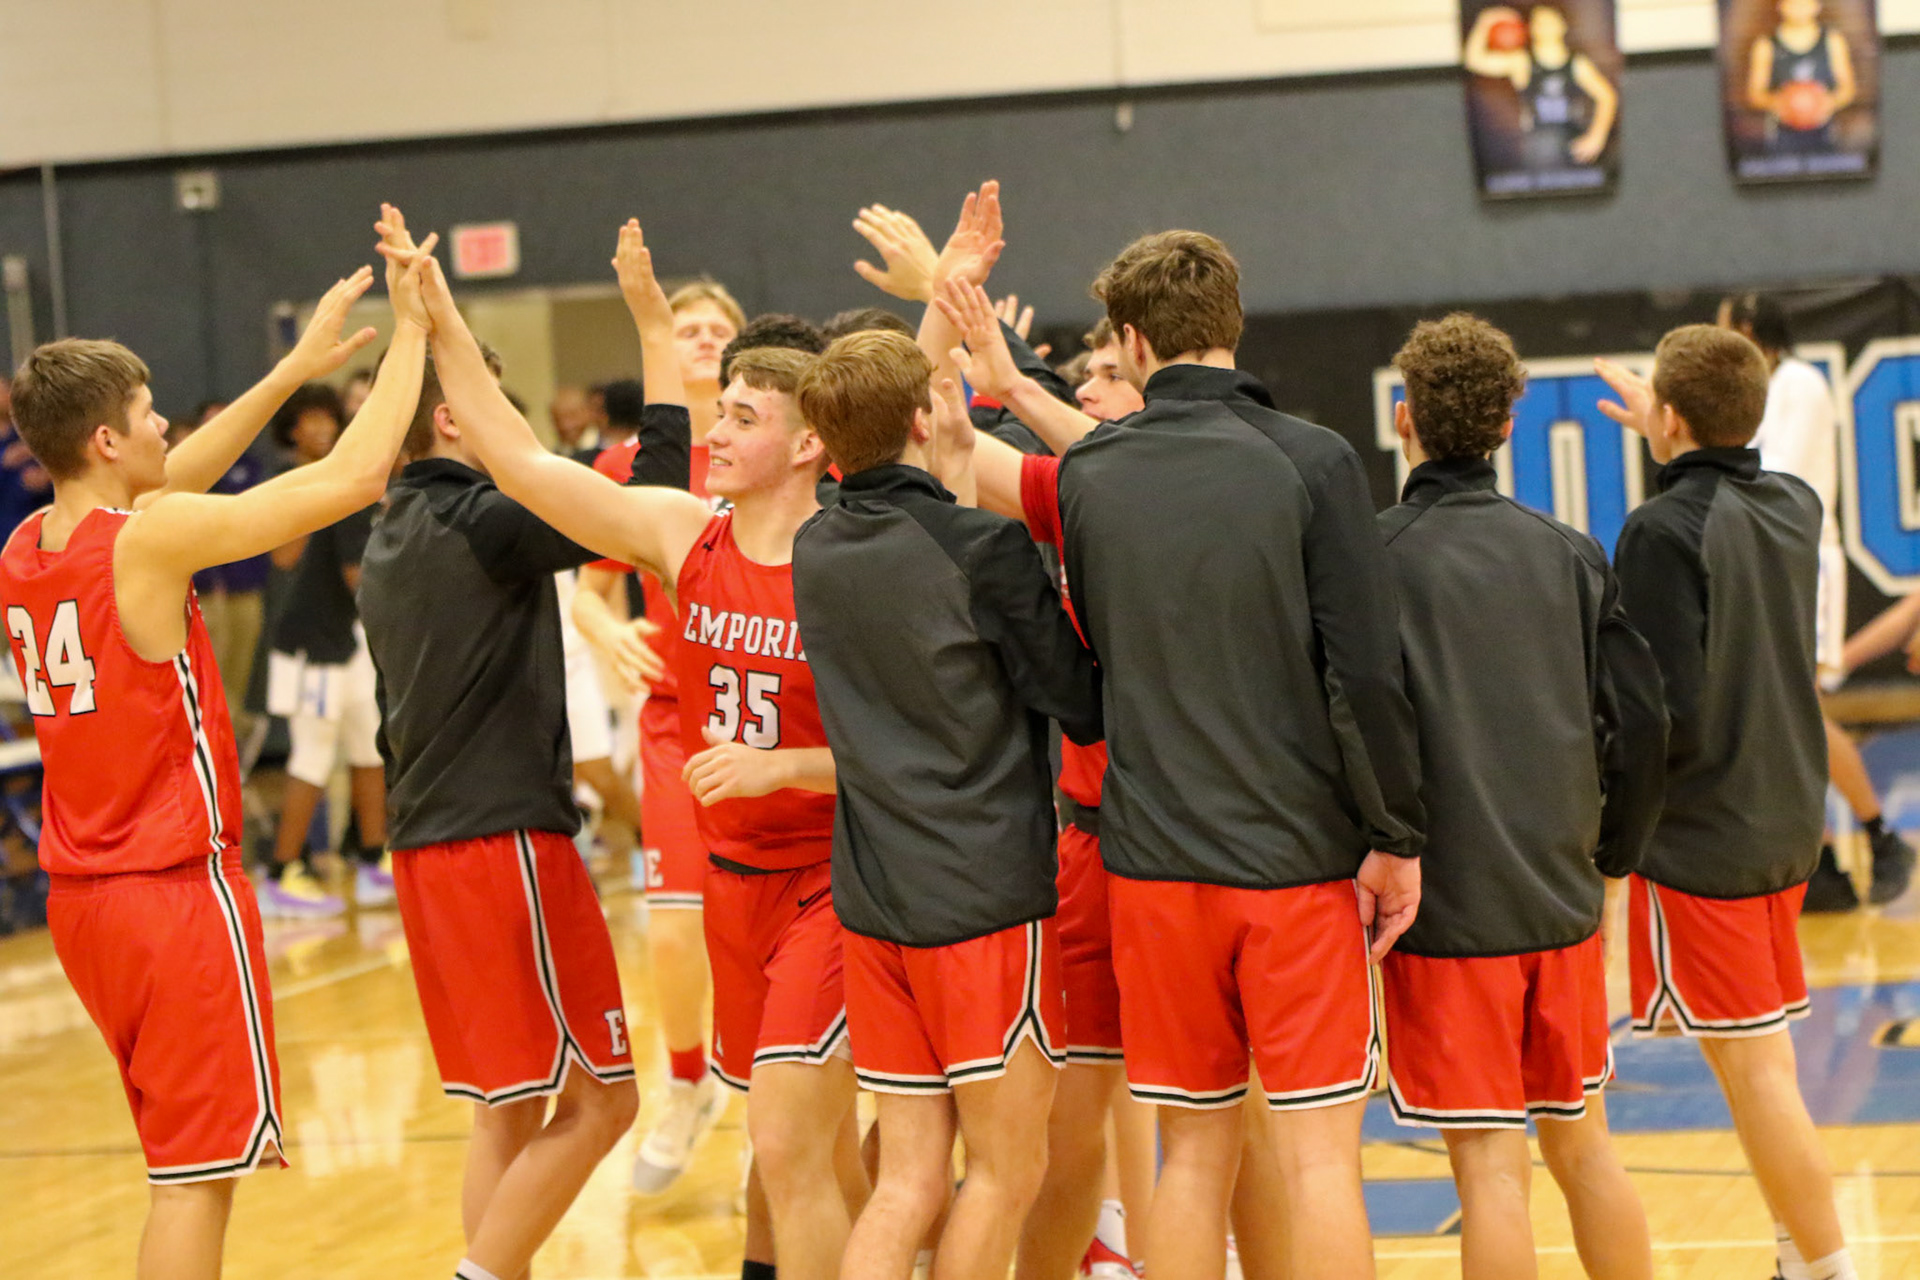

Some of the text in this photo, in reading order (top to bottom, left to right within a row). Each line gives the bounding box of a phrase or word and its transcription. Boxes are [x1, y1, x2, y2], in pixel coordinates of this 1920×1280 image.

[7, 598, 97, 717] 24
[684, 602, 807, 662] EMPORI
[708, 663, 781, 750] 35
[645, 848, 664, 888] E
[603, 1008, 627, 1057] E
